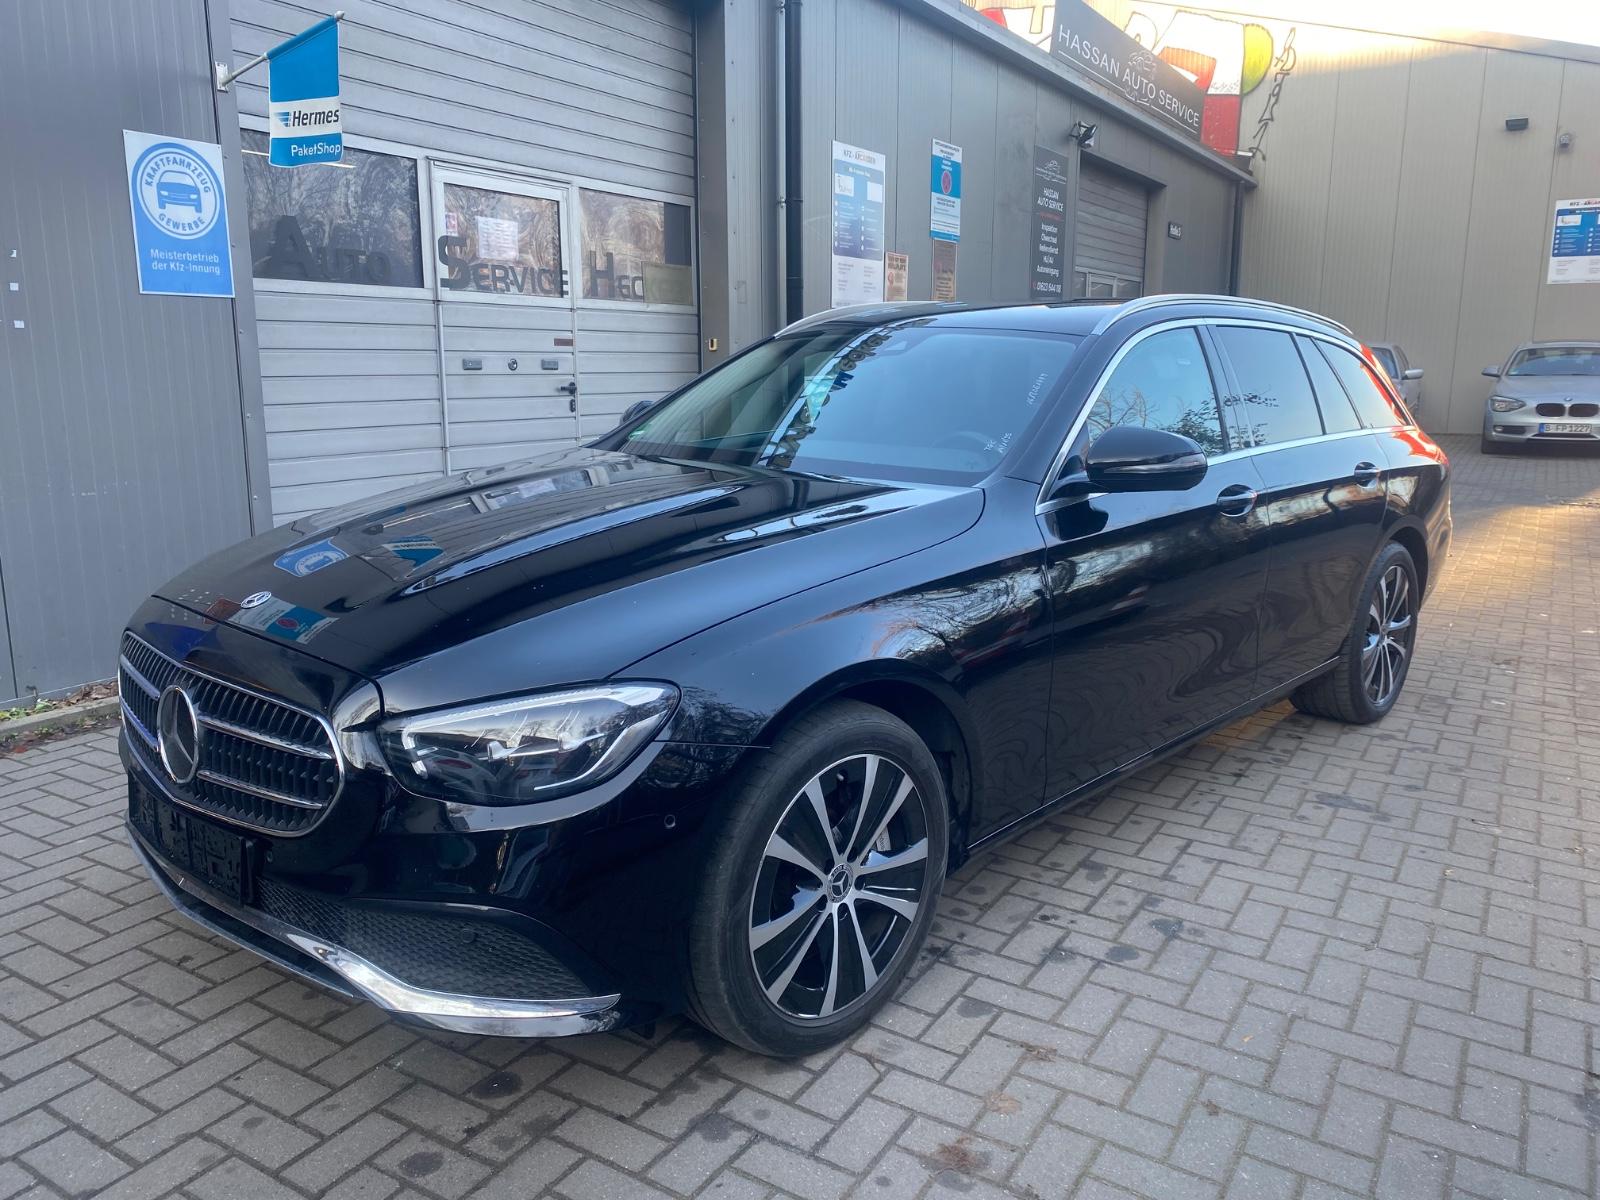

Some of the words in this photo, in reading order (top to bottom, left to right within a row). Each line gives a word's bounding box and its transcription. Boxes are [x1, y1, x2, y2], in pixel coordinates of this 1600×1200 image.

[1058, 24, 1120, 77] HASSAN
[1123, 69, 1156, 99] AUTO
[1159, 88, 1200, 128] SERVICE
[292, 107, 340, 127] Hermes
[290, 142, 342, 158] PaketShop
[144, 156, 213, 195] KRAFTFAHRZEUG
[158, 212, 207, 233] GEWERBE
[150, 248, 219, 264] Meisterbetrieb
[438, 235, 568, 295] SERVICE
[151, 261, 168, 272] der
[169, 262, 221, 276] Kfz-Innung
